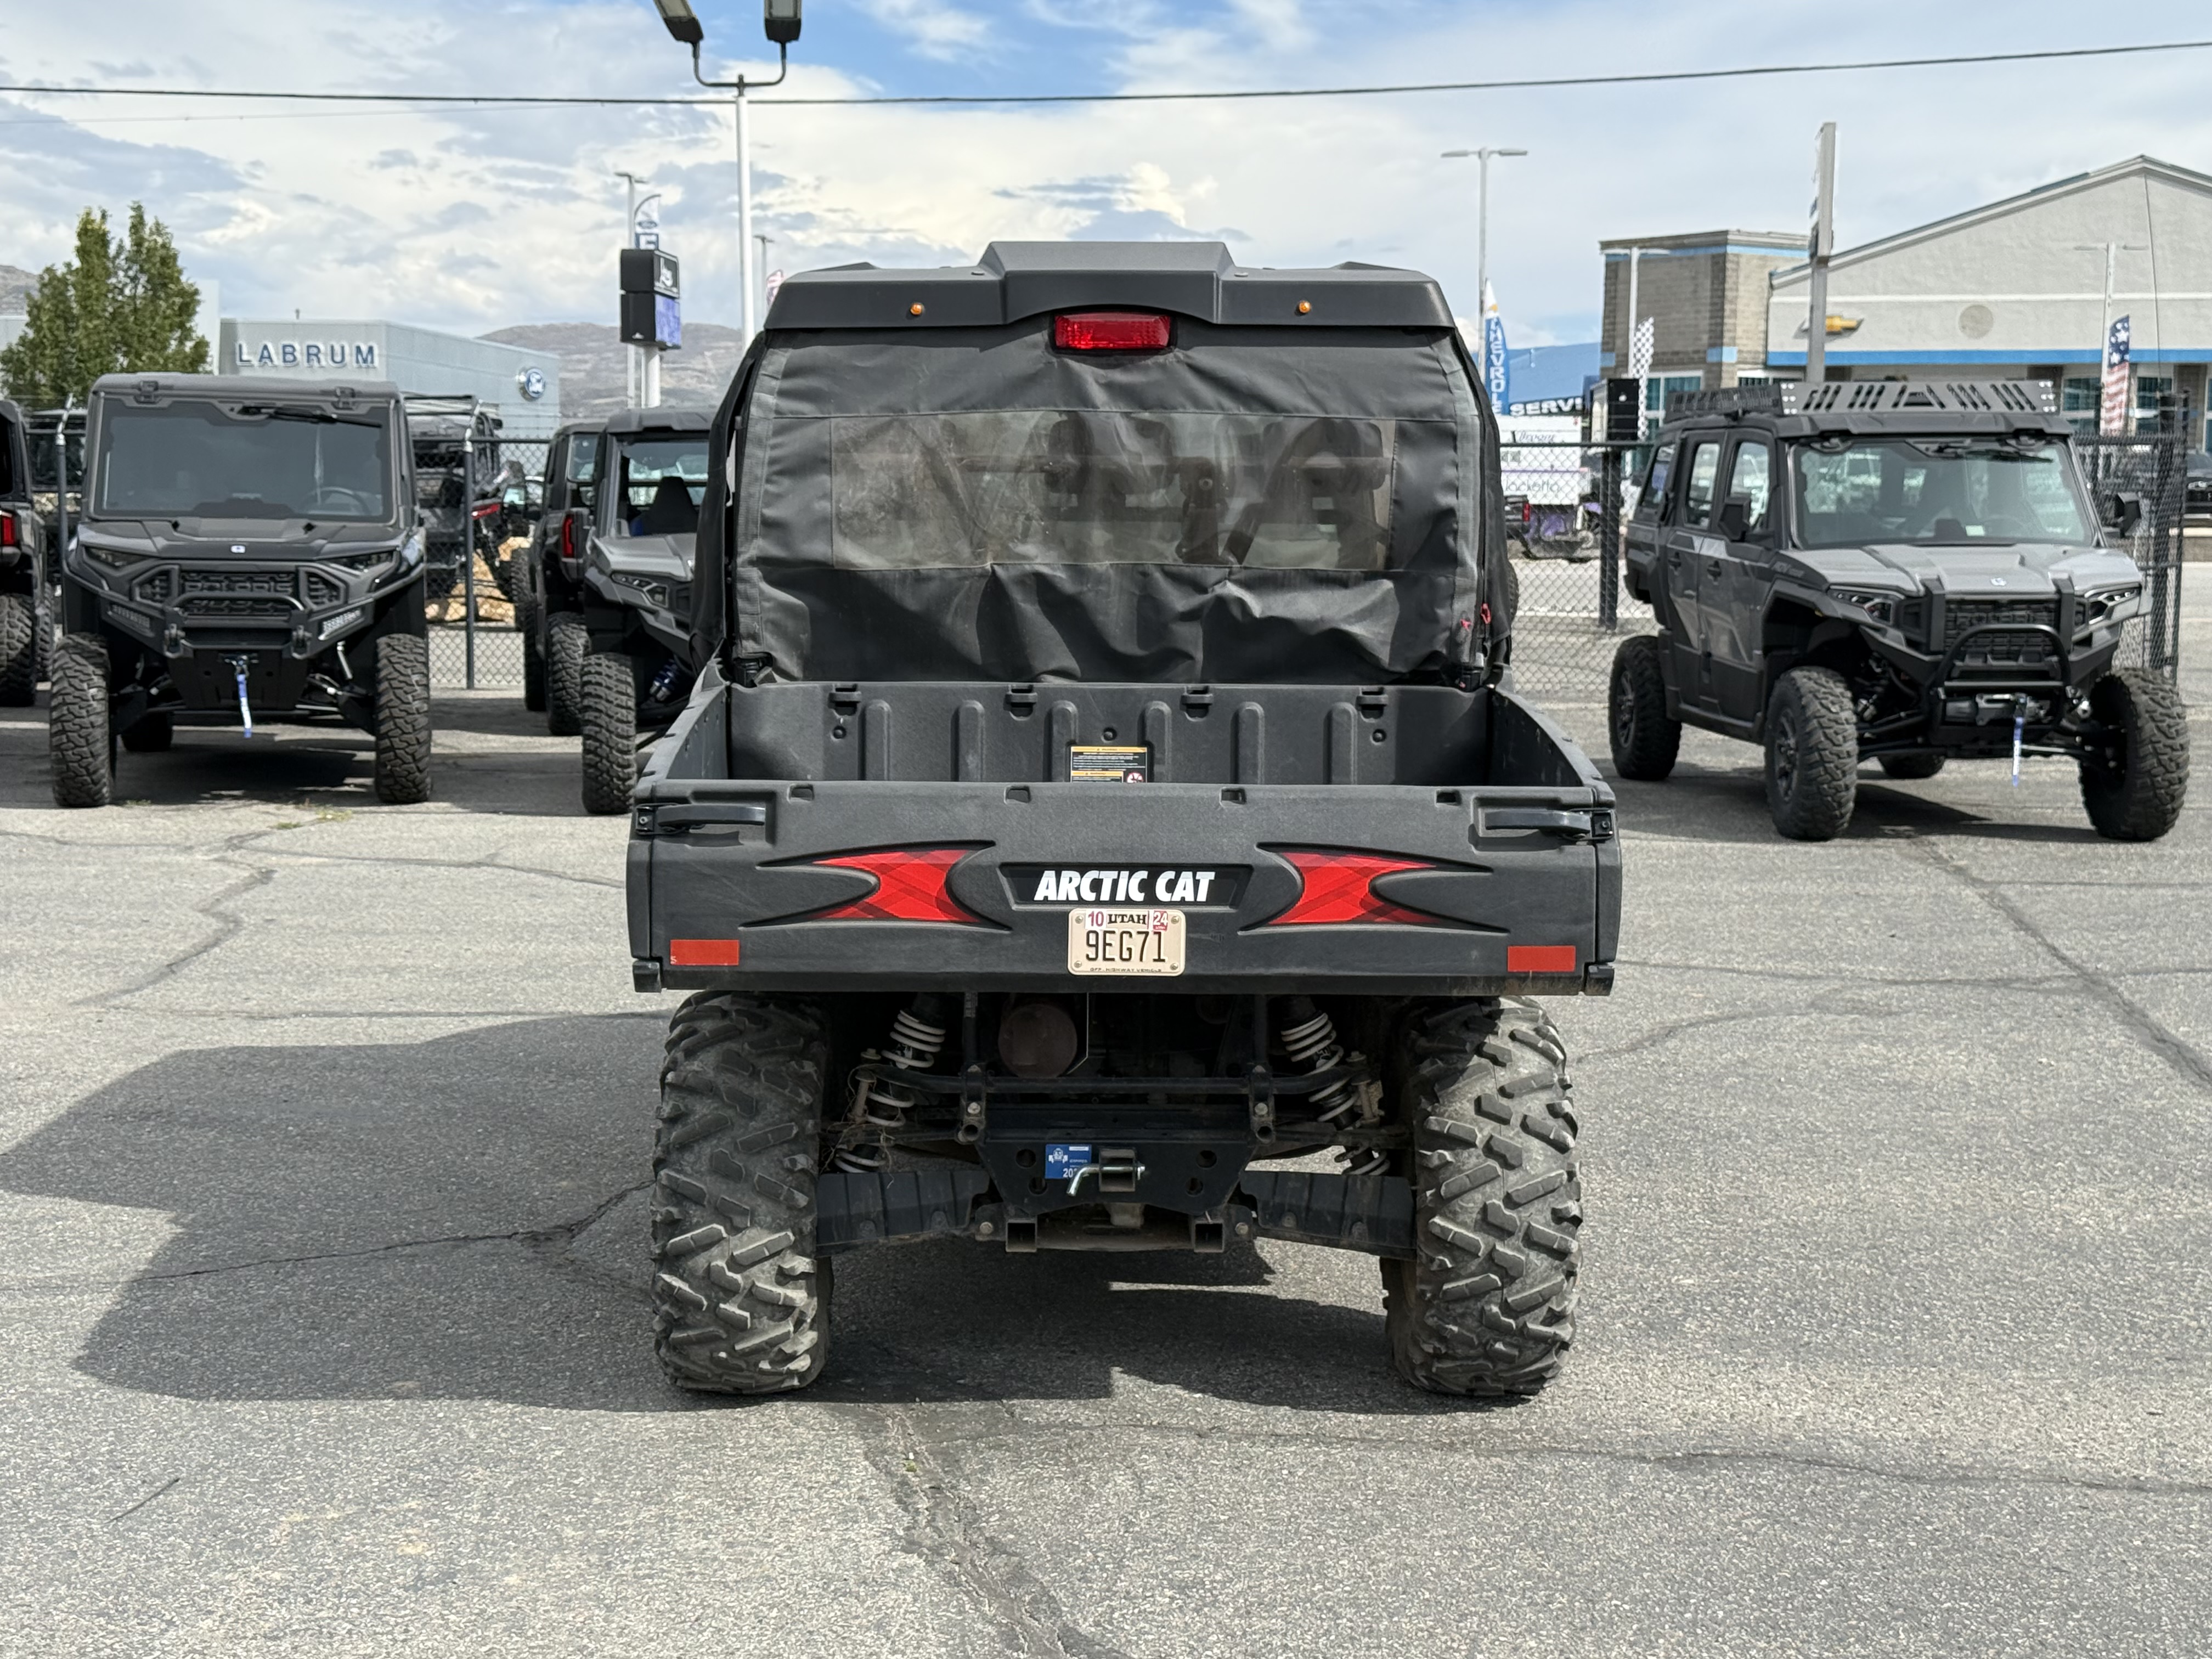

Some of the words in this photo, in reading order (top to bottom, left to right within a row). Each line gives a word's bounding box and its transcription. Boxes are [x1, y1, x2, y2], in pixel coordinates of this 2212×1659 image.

[237, 342, 377, 366] LABRUM
[1034, 870, 1148, 901] ARCTIC
[1155, 871, 1216, 902] CAT
[1088, 911, 1104, 927] 10
[1108, 913, 1147, 925] UTAH
[1153, 912, 1169, 926] 24
[1086, 930, 1166, 962] 9EG71
